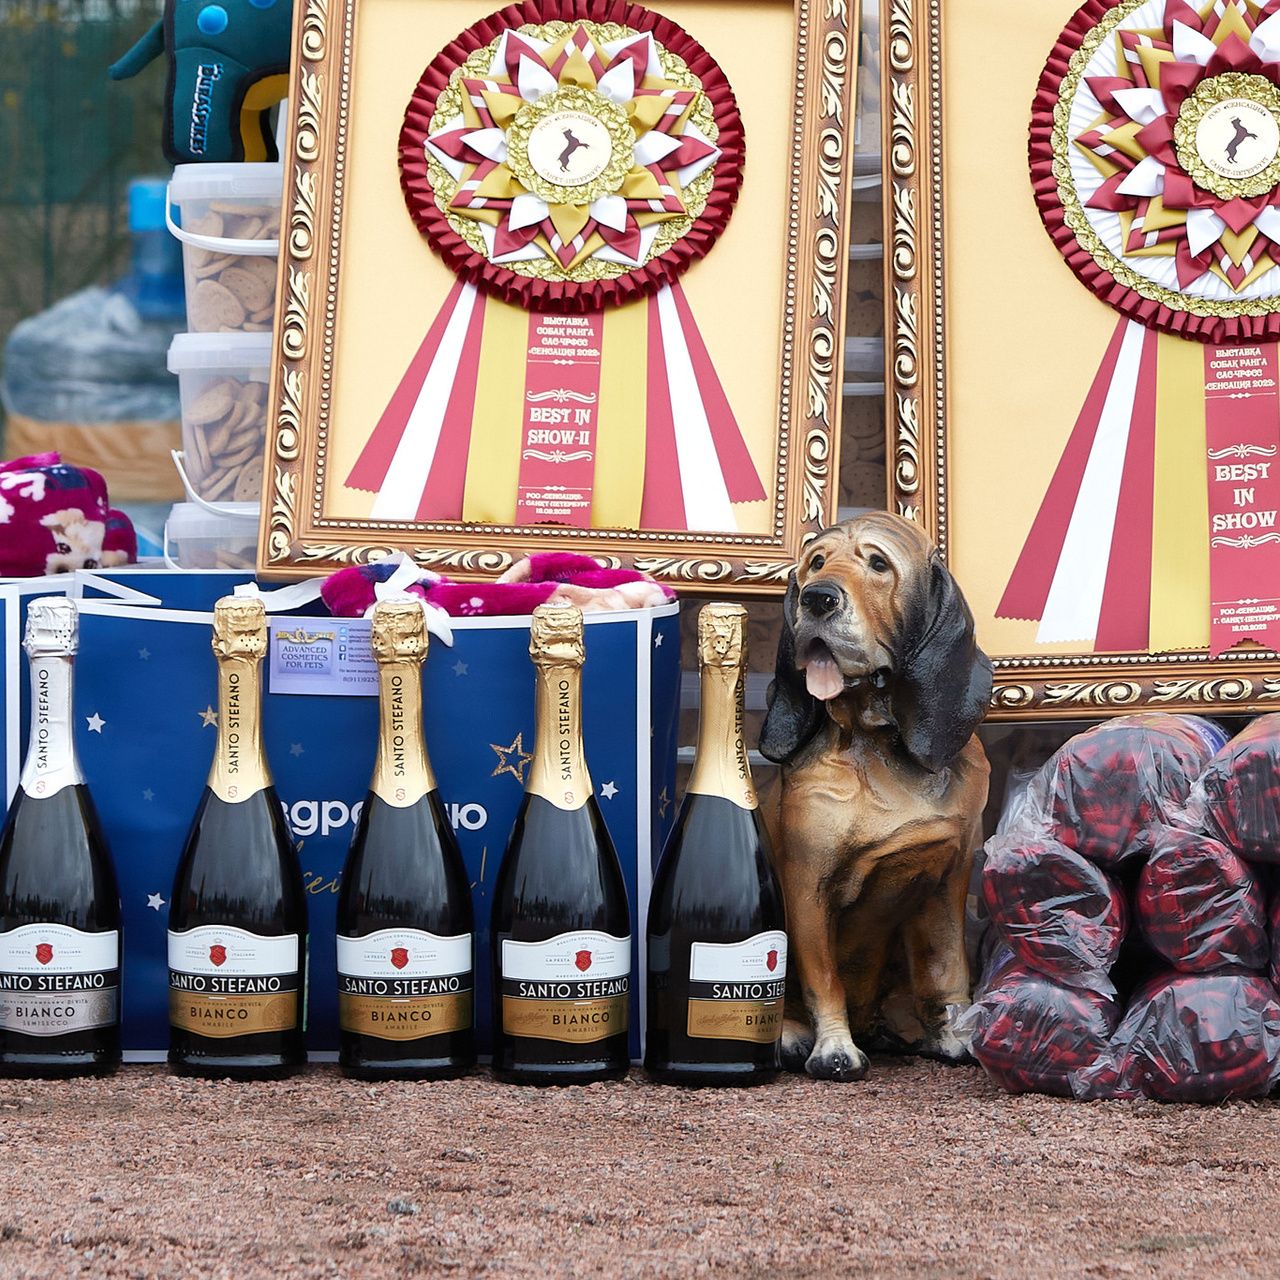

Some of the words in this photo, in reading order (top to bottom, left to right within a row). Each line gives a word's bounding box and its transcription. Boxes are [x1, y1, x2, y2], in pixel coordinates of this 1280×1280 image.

[543, 317, 589, 326] ВЫСТАВКА
[536, 327, 565, 336] СОБАК
[566, 328, 594, 336] РАНГА
[1215, 348, 1262, 358] ВЫСТАВКА
[1210, 360, 1239, 369] СОБАК
[1240, 358, 1268, 367] РАНГА
[530, 407, 572, 425] BEST
[574, 409, 592, 426] IN
[527, 429, 590, 446] SHOW-II
[1214, 462, 1271, 482] BEST
[1233, 487, 1255, 507] IN
[1212, 510, 1278, 533] SHOW
[281, 653, 328, 661] COSMETICS
[38, 669, 49, 724] STEFANO
[229, 673, 240, 728] STEFANO
[391, 675, 404, 731] STEFANO
[558, 680, 570, 734] STEFANO
[37, 728, 49, 769] SANTO
[228, 733, 240, 774] SANTO
[393, 735, 405, 777] SANTO
[559, 739, 572, 780] SANTO
[735, 738, 747, 779] SANTO
[0, 976, 32, 990] NTO
[38, 974, 105, 990] STEFANO
[171, 972, 206, 991] SANTO
[211, 977, 281, 993] STEFANO
[345, 978, 388, 995] SANTO
[394, 977, 460, 994] STEFANO
[519, 982, 571, 998] SANTO
[577, 978, 629, 997] STEFANO
[713, 984, 763, 998] SANTO
[16, 1006, 75, 1018] BIANCO
[190, 1006, 248, 1020] BIANCO
[371, 1010, 432, 1021] BIANCO
[552, 1012, 610, 1025] BIANCO
